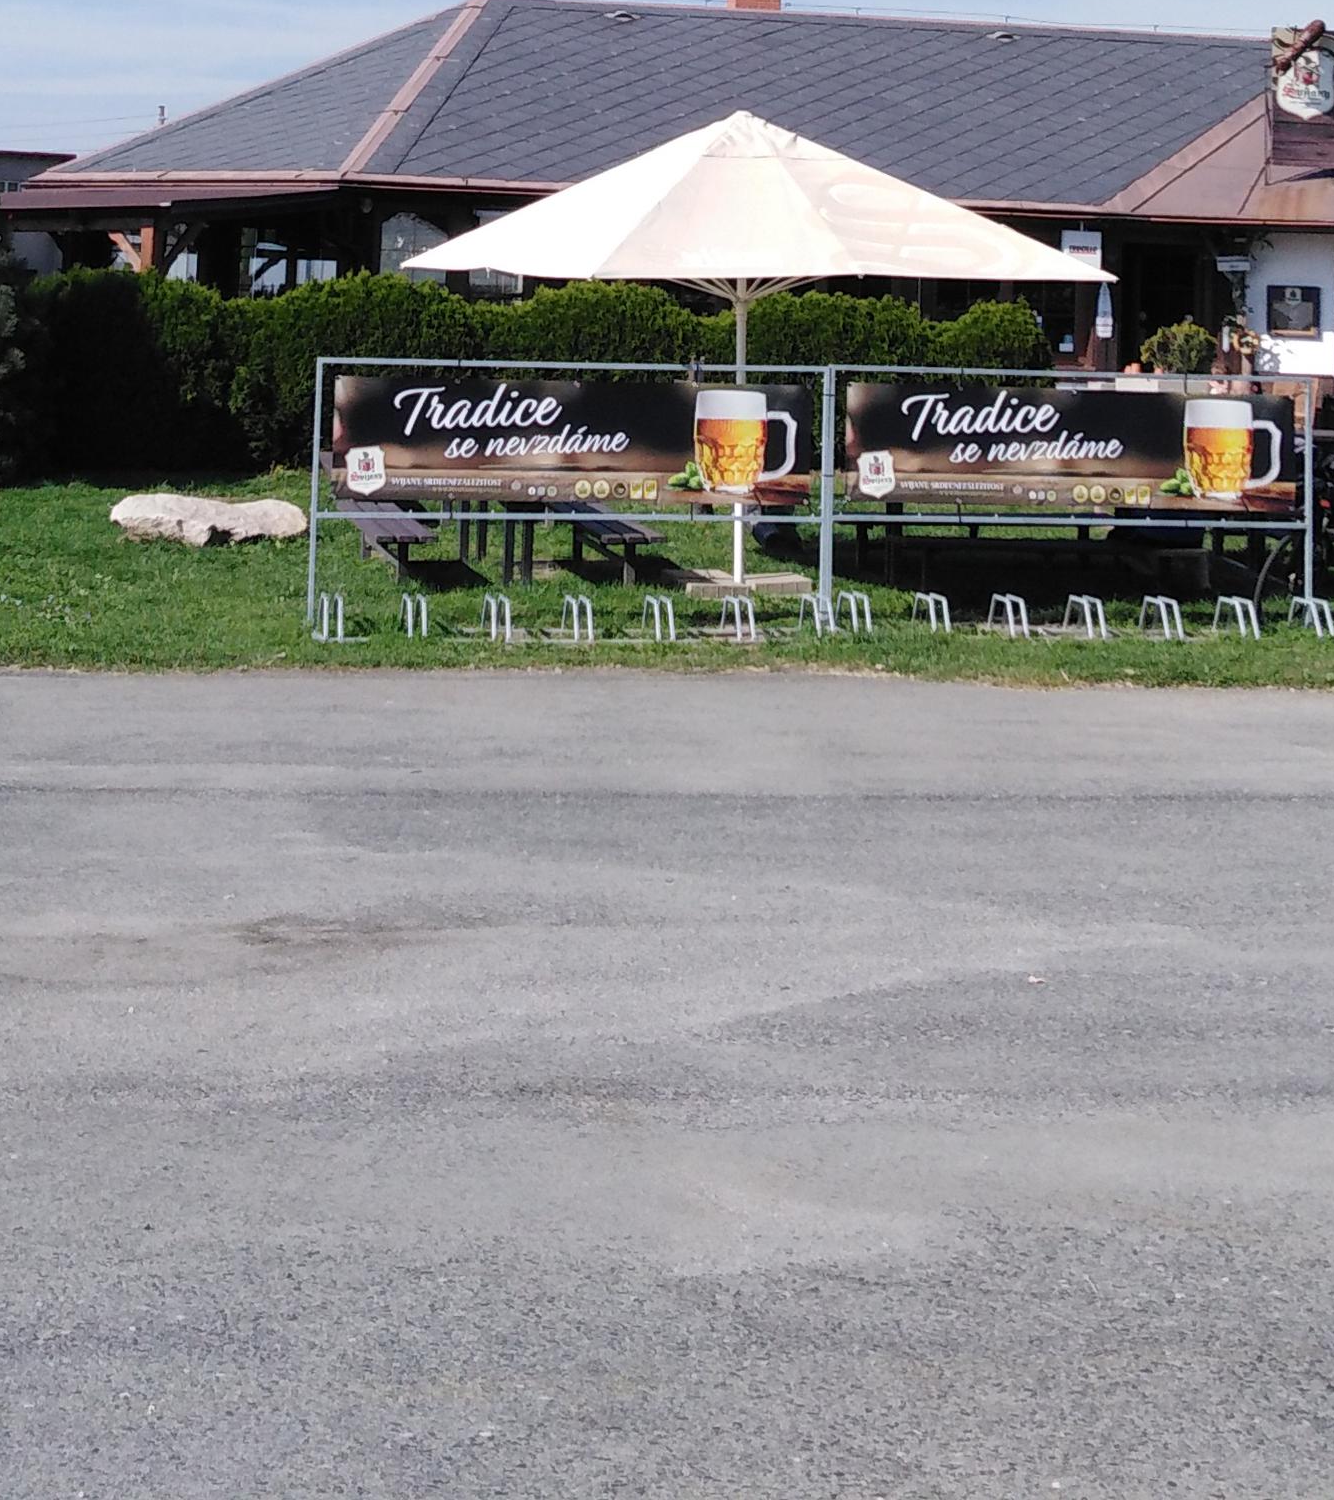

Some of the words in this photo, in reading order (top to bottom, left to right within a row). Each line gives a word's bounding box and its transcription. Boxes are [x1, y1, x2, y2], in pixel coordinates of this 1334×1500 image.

[393, 382, 563, 437] Tradice
[900, 390, 1061, 442] Tradice
[443, 436, 480, 459] se
[485, 424, 630, 458] nevzdáme
[948, 441, 983, 463] se
[987, 430, 1124, 463] nevzdáme
